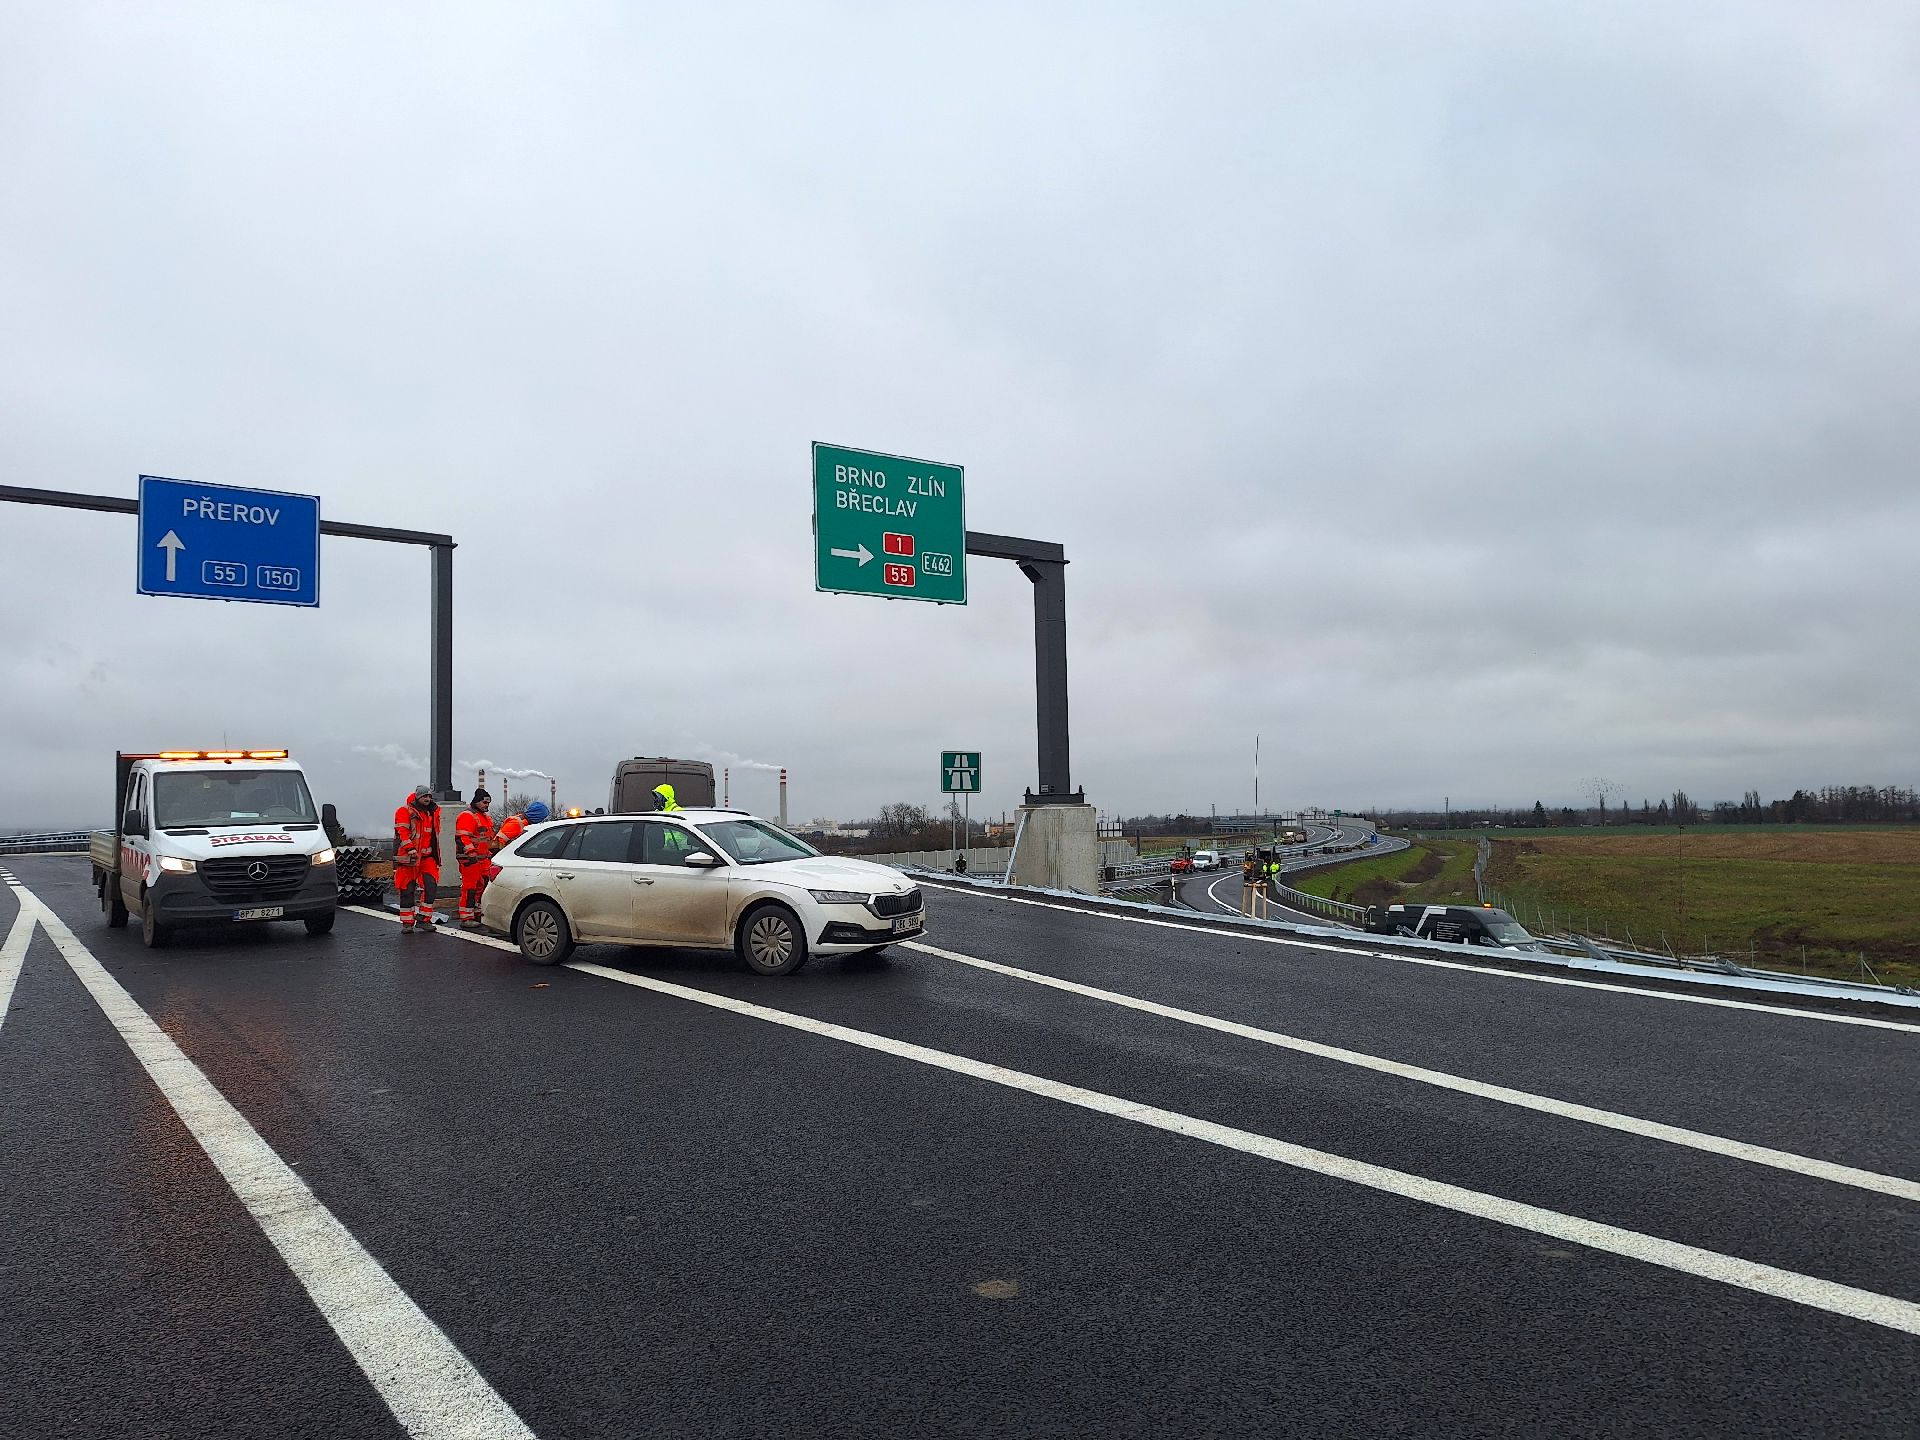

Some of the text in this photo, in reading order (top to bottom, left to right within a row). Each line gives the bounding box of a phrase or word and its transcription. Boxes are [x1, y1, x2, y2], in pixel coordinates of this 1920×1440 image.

[835, 464, 945, 498] BRNO ZLÍN
[183, 496, 280, 526] PŘEROV
[836, 488, 917, 518] BŘECLAV
[896, 537, 902, 552] 1
[924, 555, 950, 573] E462
[214, 565, 236, 582] 55
[264, 570, 293, 586] 150
[891, 567, 908, 583] 55
[209, 834, 292, 845] STRABAG
